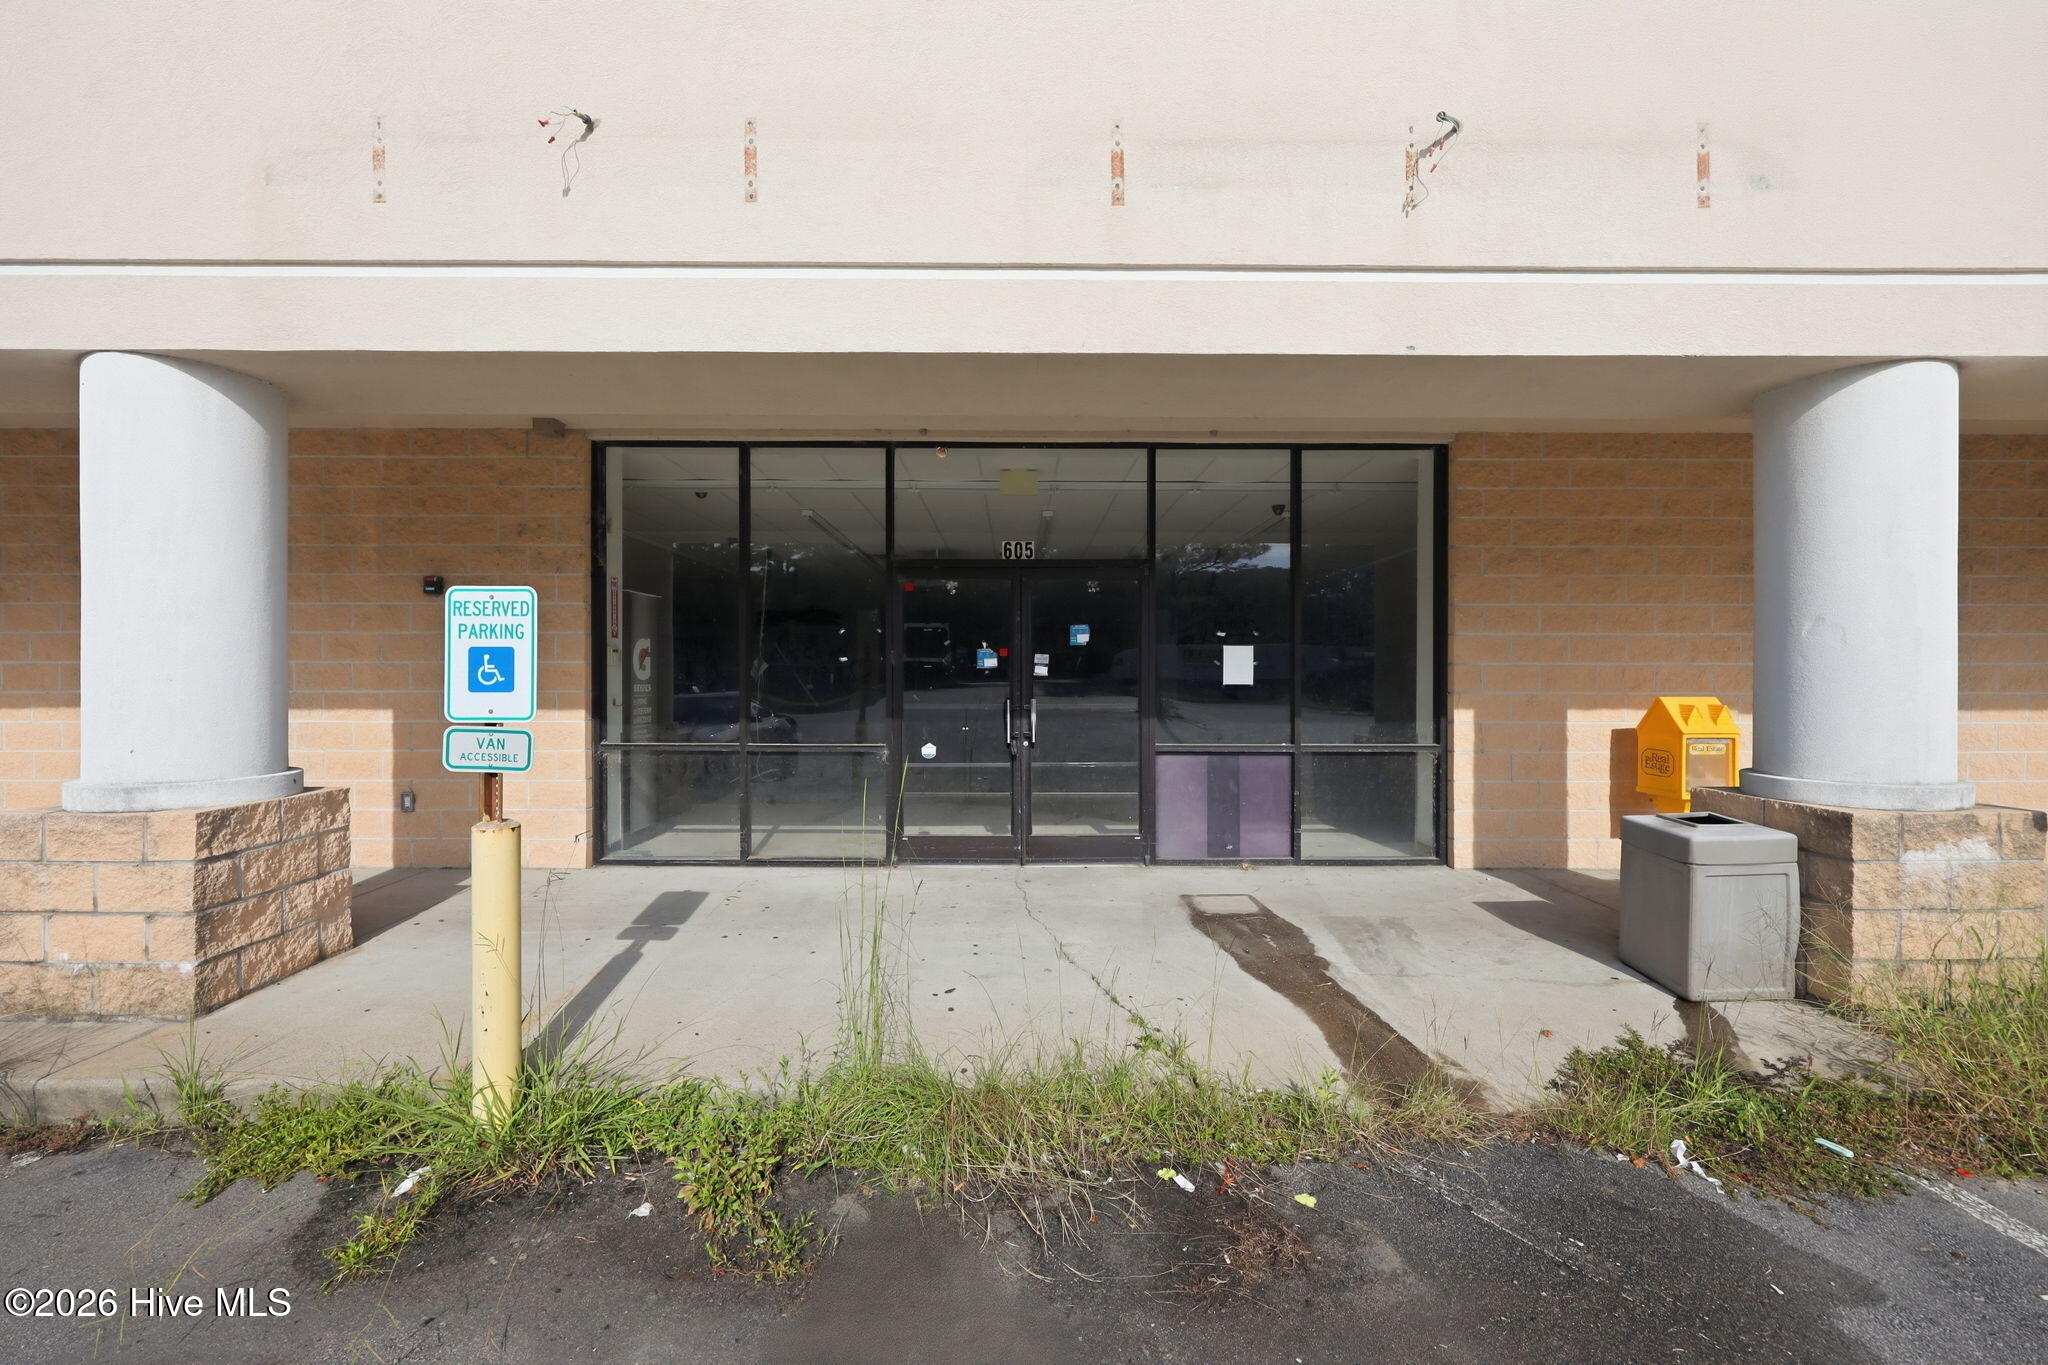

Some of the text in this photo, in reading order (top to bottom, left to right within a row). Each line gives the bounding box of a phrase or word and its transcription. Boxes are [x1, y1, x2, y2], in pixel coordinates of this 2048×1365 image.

[1003, 541, 1034, 559] 605
[453, 600, 530, 617] RESERVED
[458, 623, 525, 640] PARKING
[476, 737, 505, 750] VAN
[459, 752, 519, 763] ACCESSIBLE
[1651, 752, 1670, 764] Real
[1645, 759, 1671, 773] Estate
